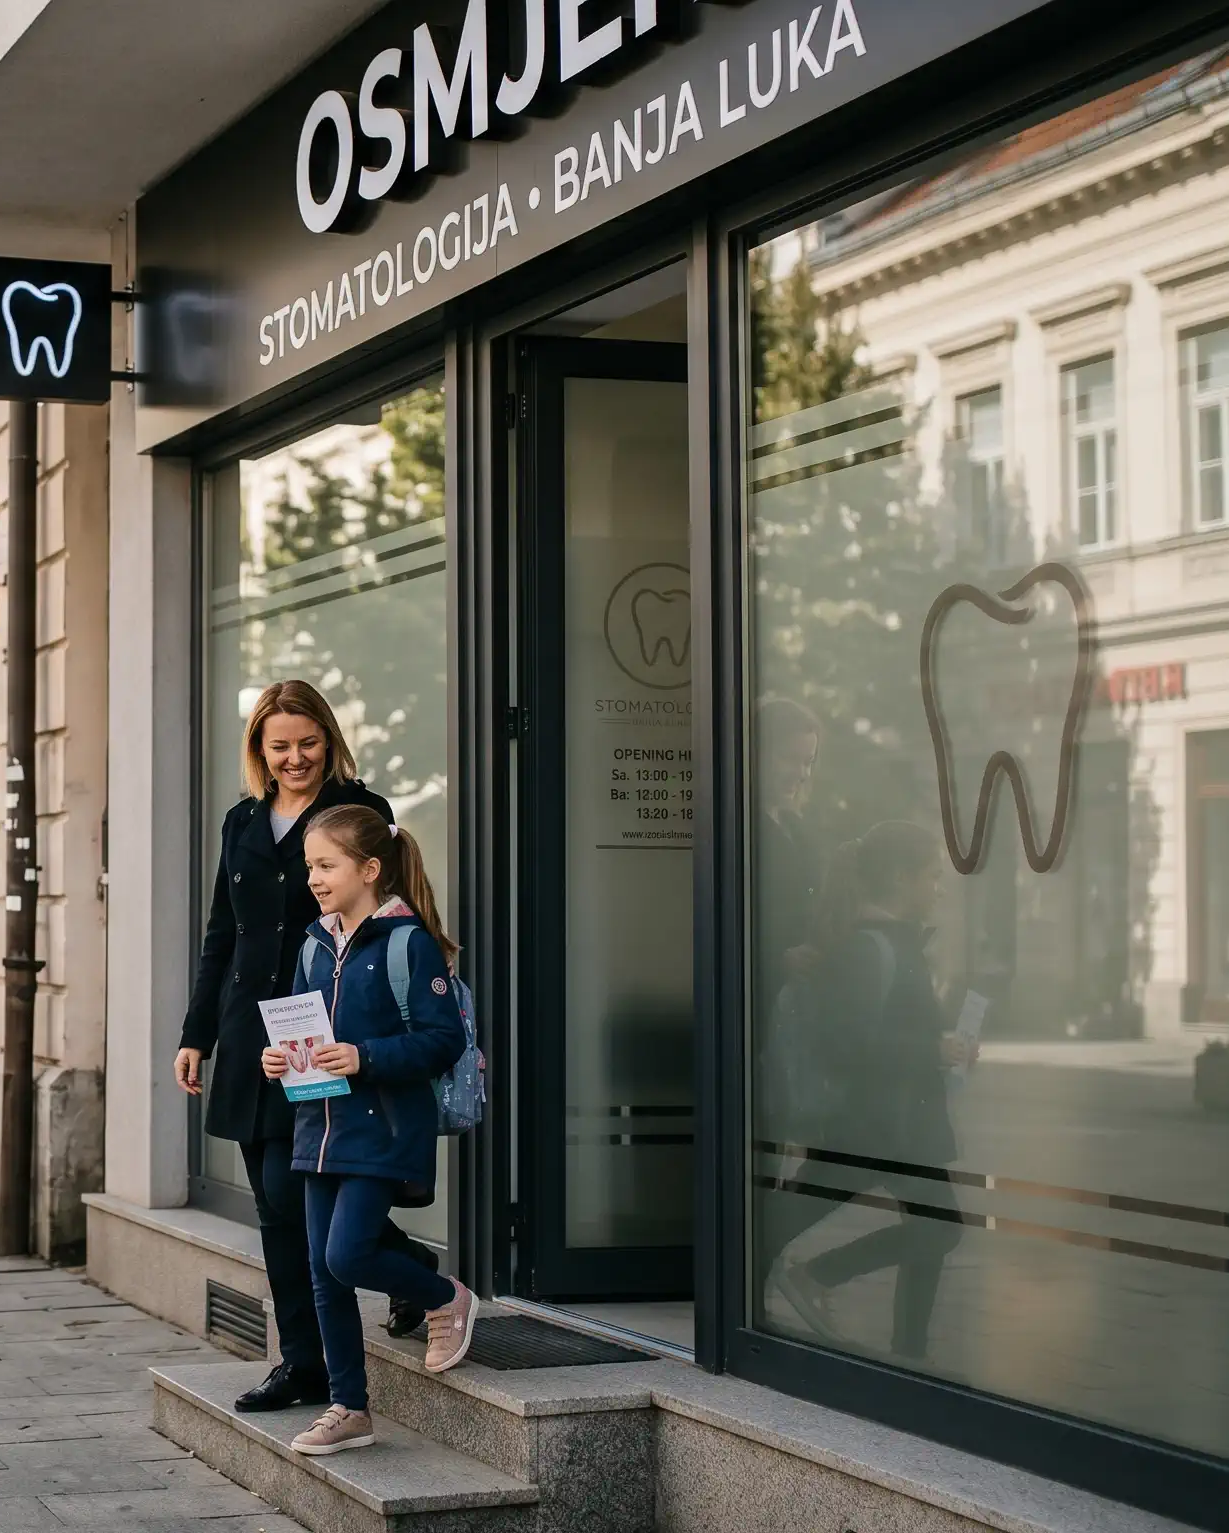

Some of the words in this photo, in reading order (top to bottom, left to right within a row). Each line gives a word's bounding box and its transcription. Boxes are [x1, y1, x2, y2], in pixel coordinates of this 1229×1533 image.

[296, 0, 658, 233] OSMJE
[259, 183, 518, 366] STOMATOLOGIJA
[554, 80, 704, 214] BANJA
[719, 0, 867, 128] LUKA
[613, 748, 674, 761] OPENING
[611, 768, 630, 780] Sa.
[635, 768, 668, 781] 13:00
[610, 788, 630, 800] Ba:
[635, 788, 669, 801] 12:00
[636, 807, 669, 820] 13:20
